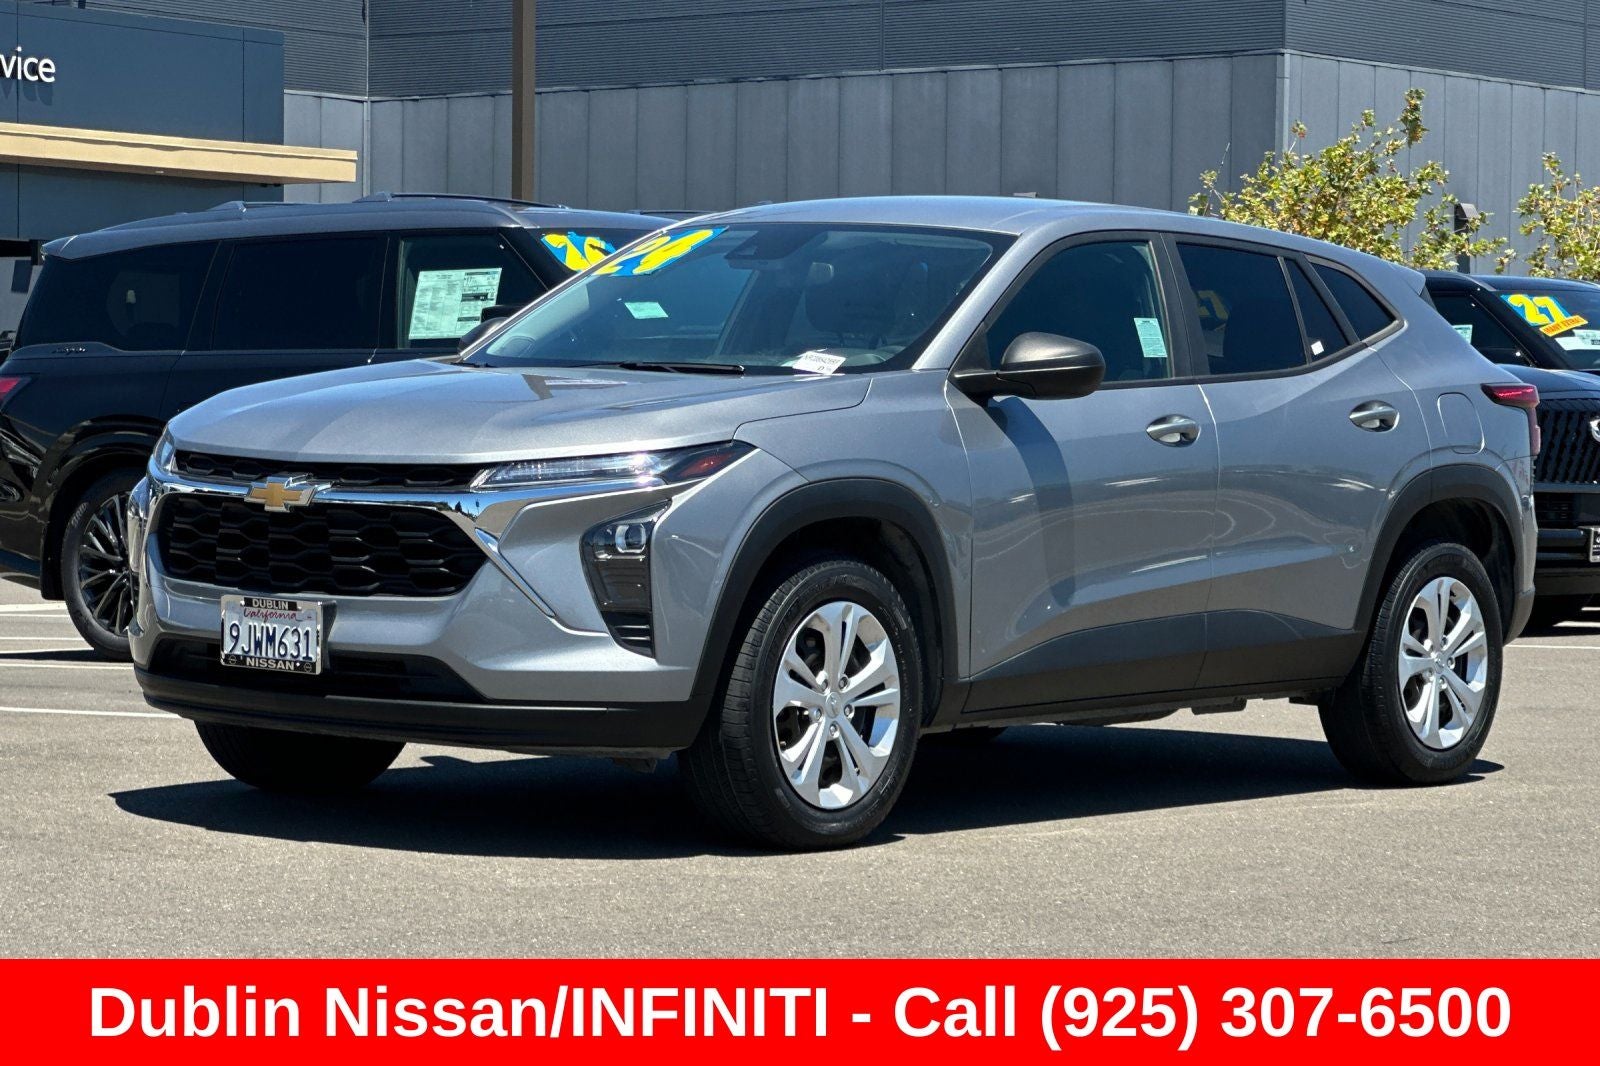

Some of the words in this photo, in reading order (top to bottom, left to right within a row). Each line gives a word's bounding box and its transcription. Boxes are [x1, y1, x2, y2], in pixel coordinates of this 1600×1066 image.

[591, 229, 714, 275] 24
[1507, 294, 1567, 325] 27
[243, 607, 303, 623] California
[251, 598, 289, 610] DUBLIN
[228, 621, 314, 661] 9JWM631
[245, 657, 295, 671] NISSAN
